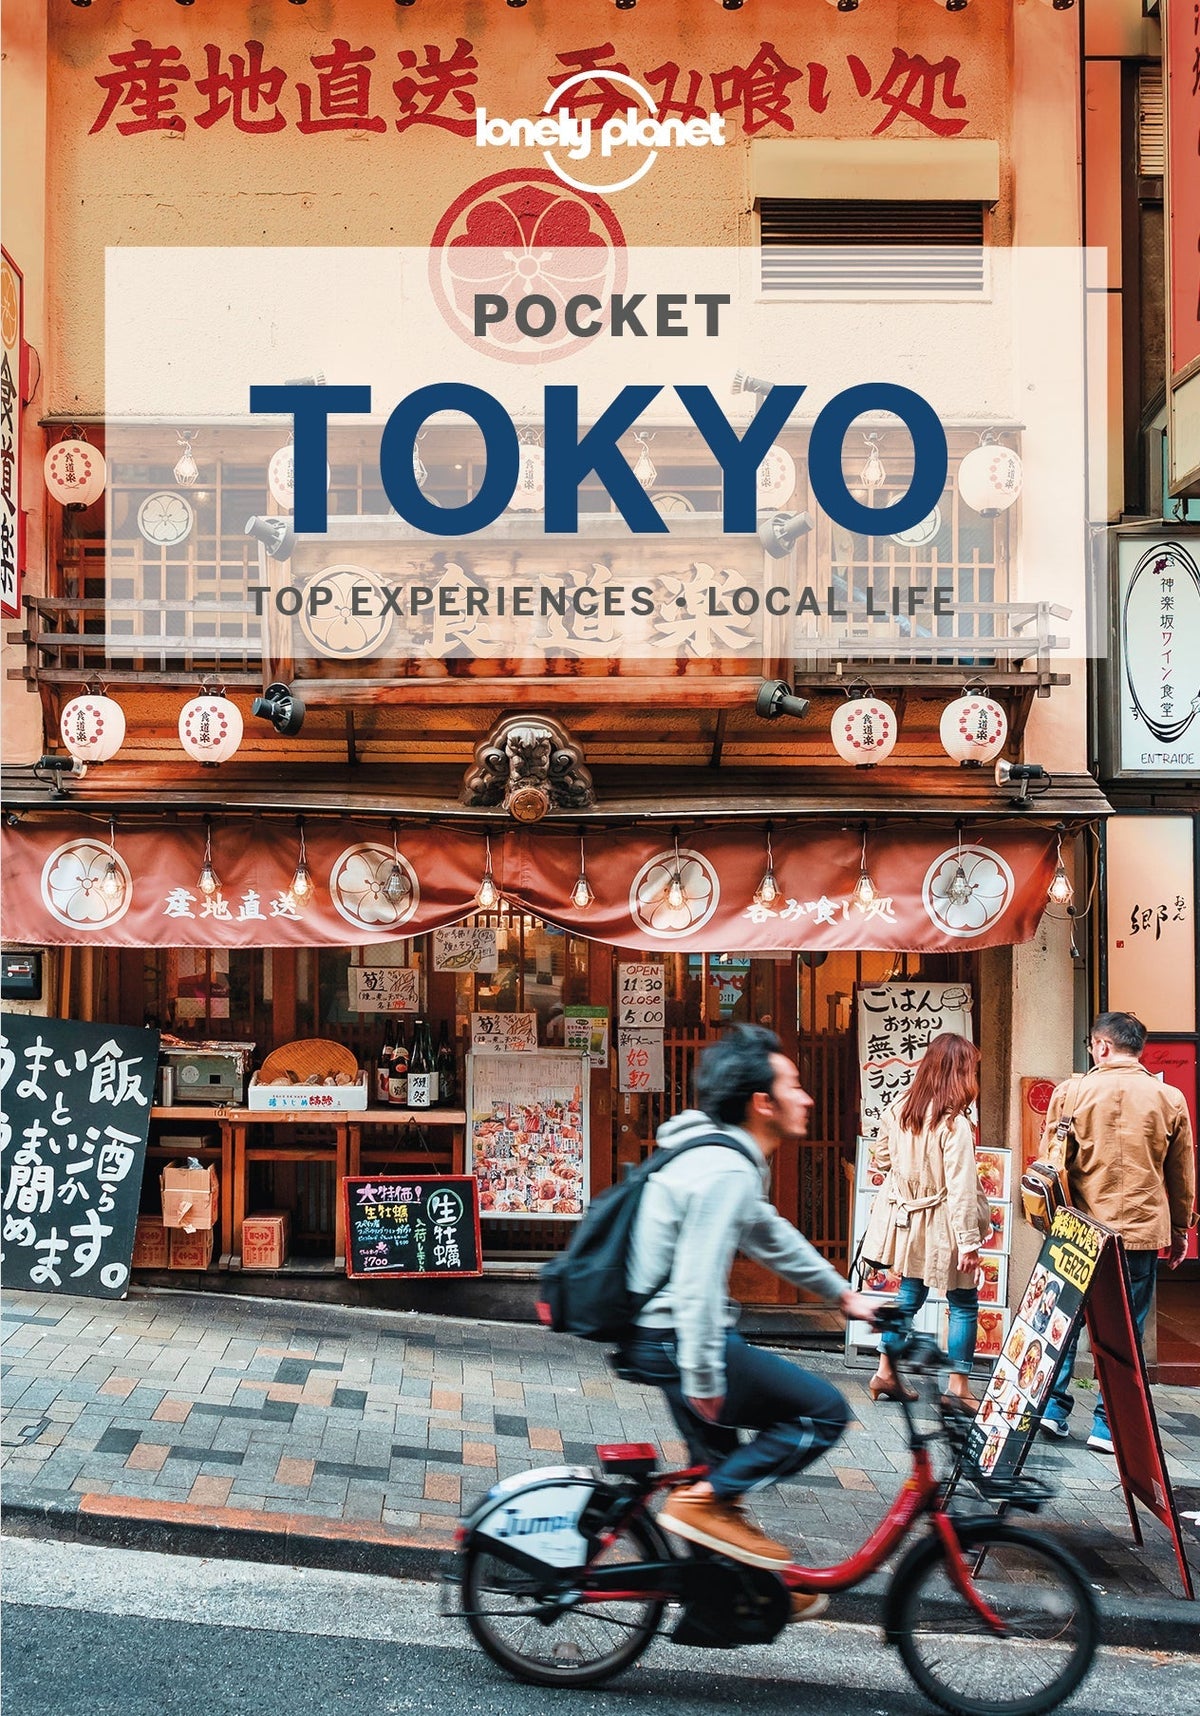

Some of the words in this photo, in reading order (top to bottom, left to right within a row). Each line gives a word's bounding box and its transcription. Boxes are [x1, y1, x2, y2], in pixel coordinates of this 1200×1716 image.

[88, 38, 480, 137] 産地直送
[1159, 577, 1175, 718] 神楽坂ワイン食堂
[1141, 753, 1195, 765] ENTRAIDE
[162, 887, 304, 922] 産地直送
[626, 965, 660, 976] OPEN
[623, 978, 662, 992] 11:30
[863, 987, 943, 1013] ごはん
[624, 1009, 663, 1024] 5:00
[883, 1016, 943, 1033] おかわり
[51, 1091, 73, 1126] と
[1059, 1246, 1090, 1285] TERZO
